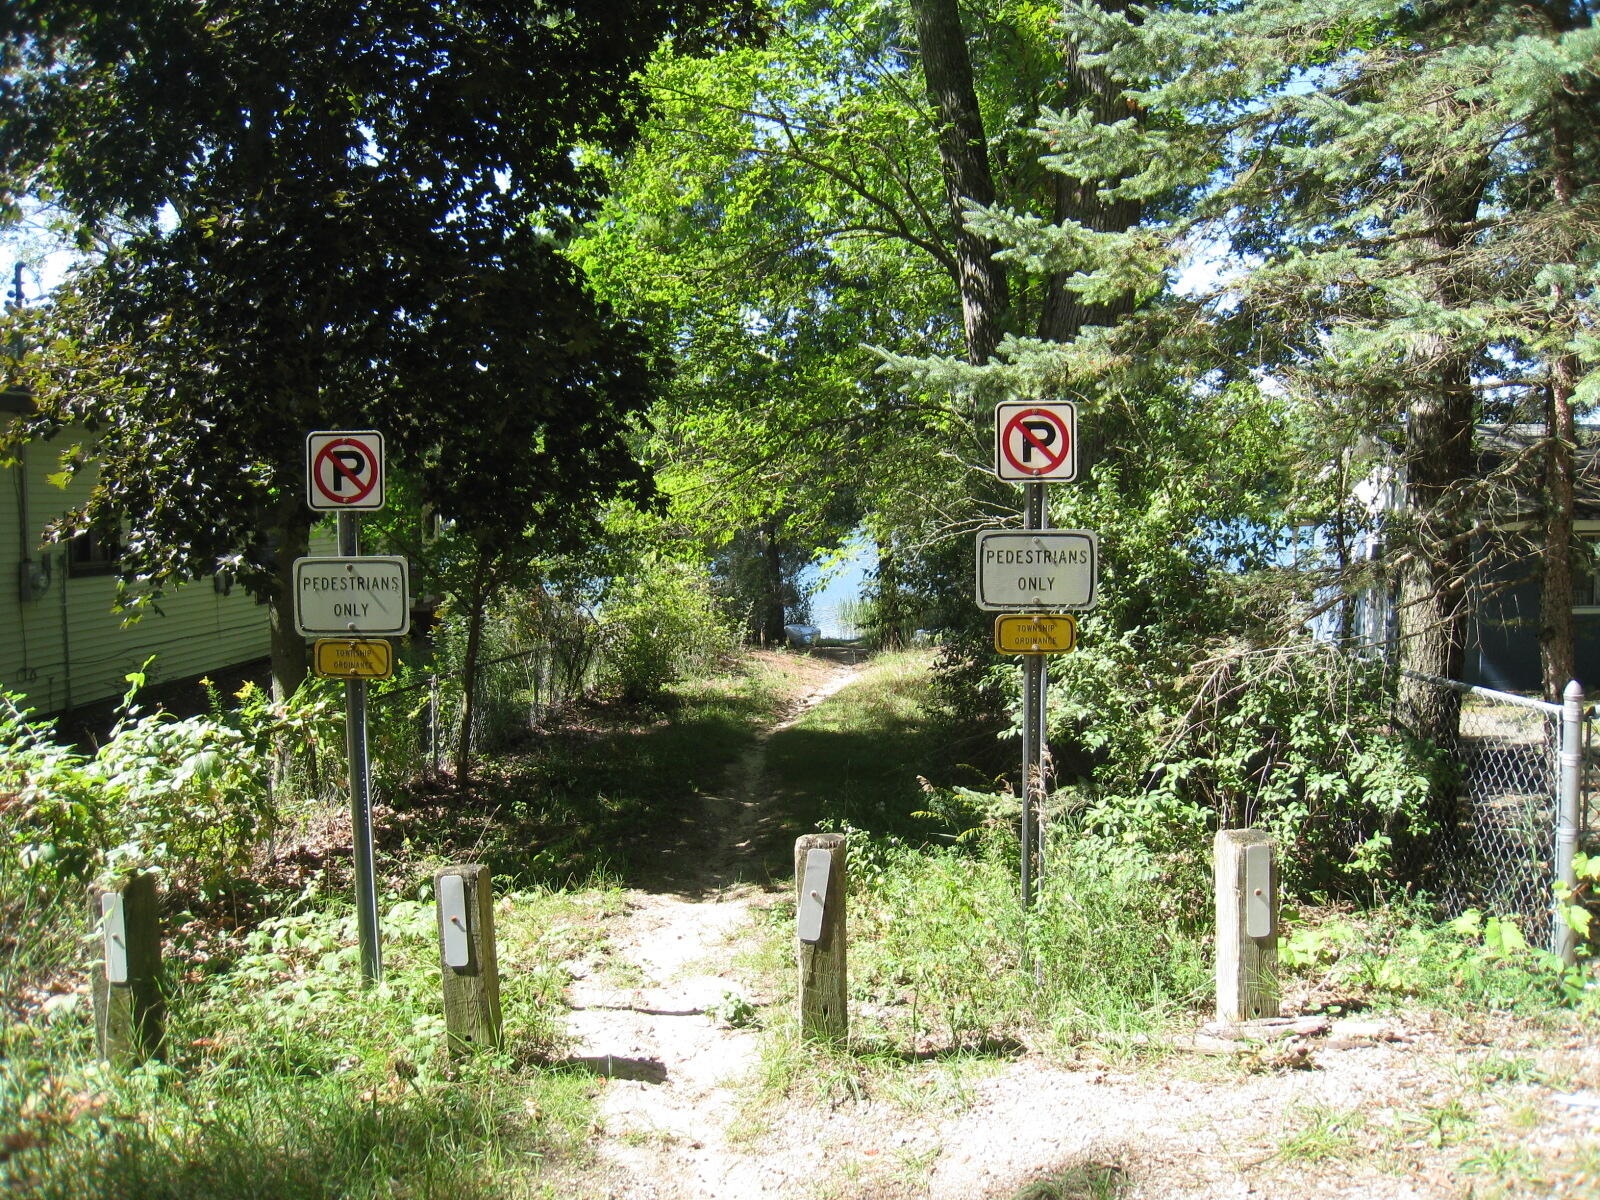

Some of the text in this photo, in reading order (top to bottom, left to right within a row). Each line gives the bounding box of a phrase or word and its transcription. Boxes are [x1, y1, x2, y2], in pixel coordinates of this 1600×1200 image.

[986, 550, 1088, 564] PEDESTRIANS
[303, 576, 400, 591] PEDESTRIANS
[1018, 577, 1055, 591] ONLY
[333, 603, 369, 617] ONLY
[1017, 624, 1055, 632] TOWNSHIP
[1014, 637, 1057, 645] ORDINANCE
[335, 649, 372, 657] TOWNSHIP
